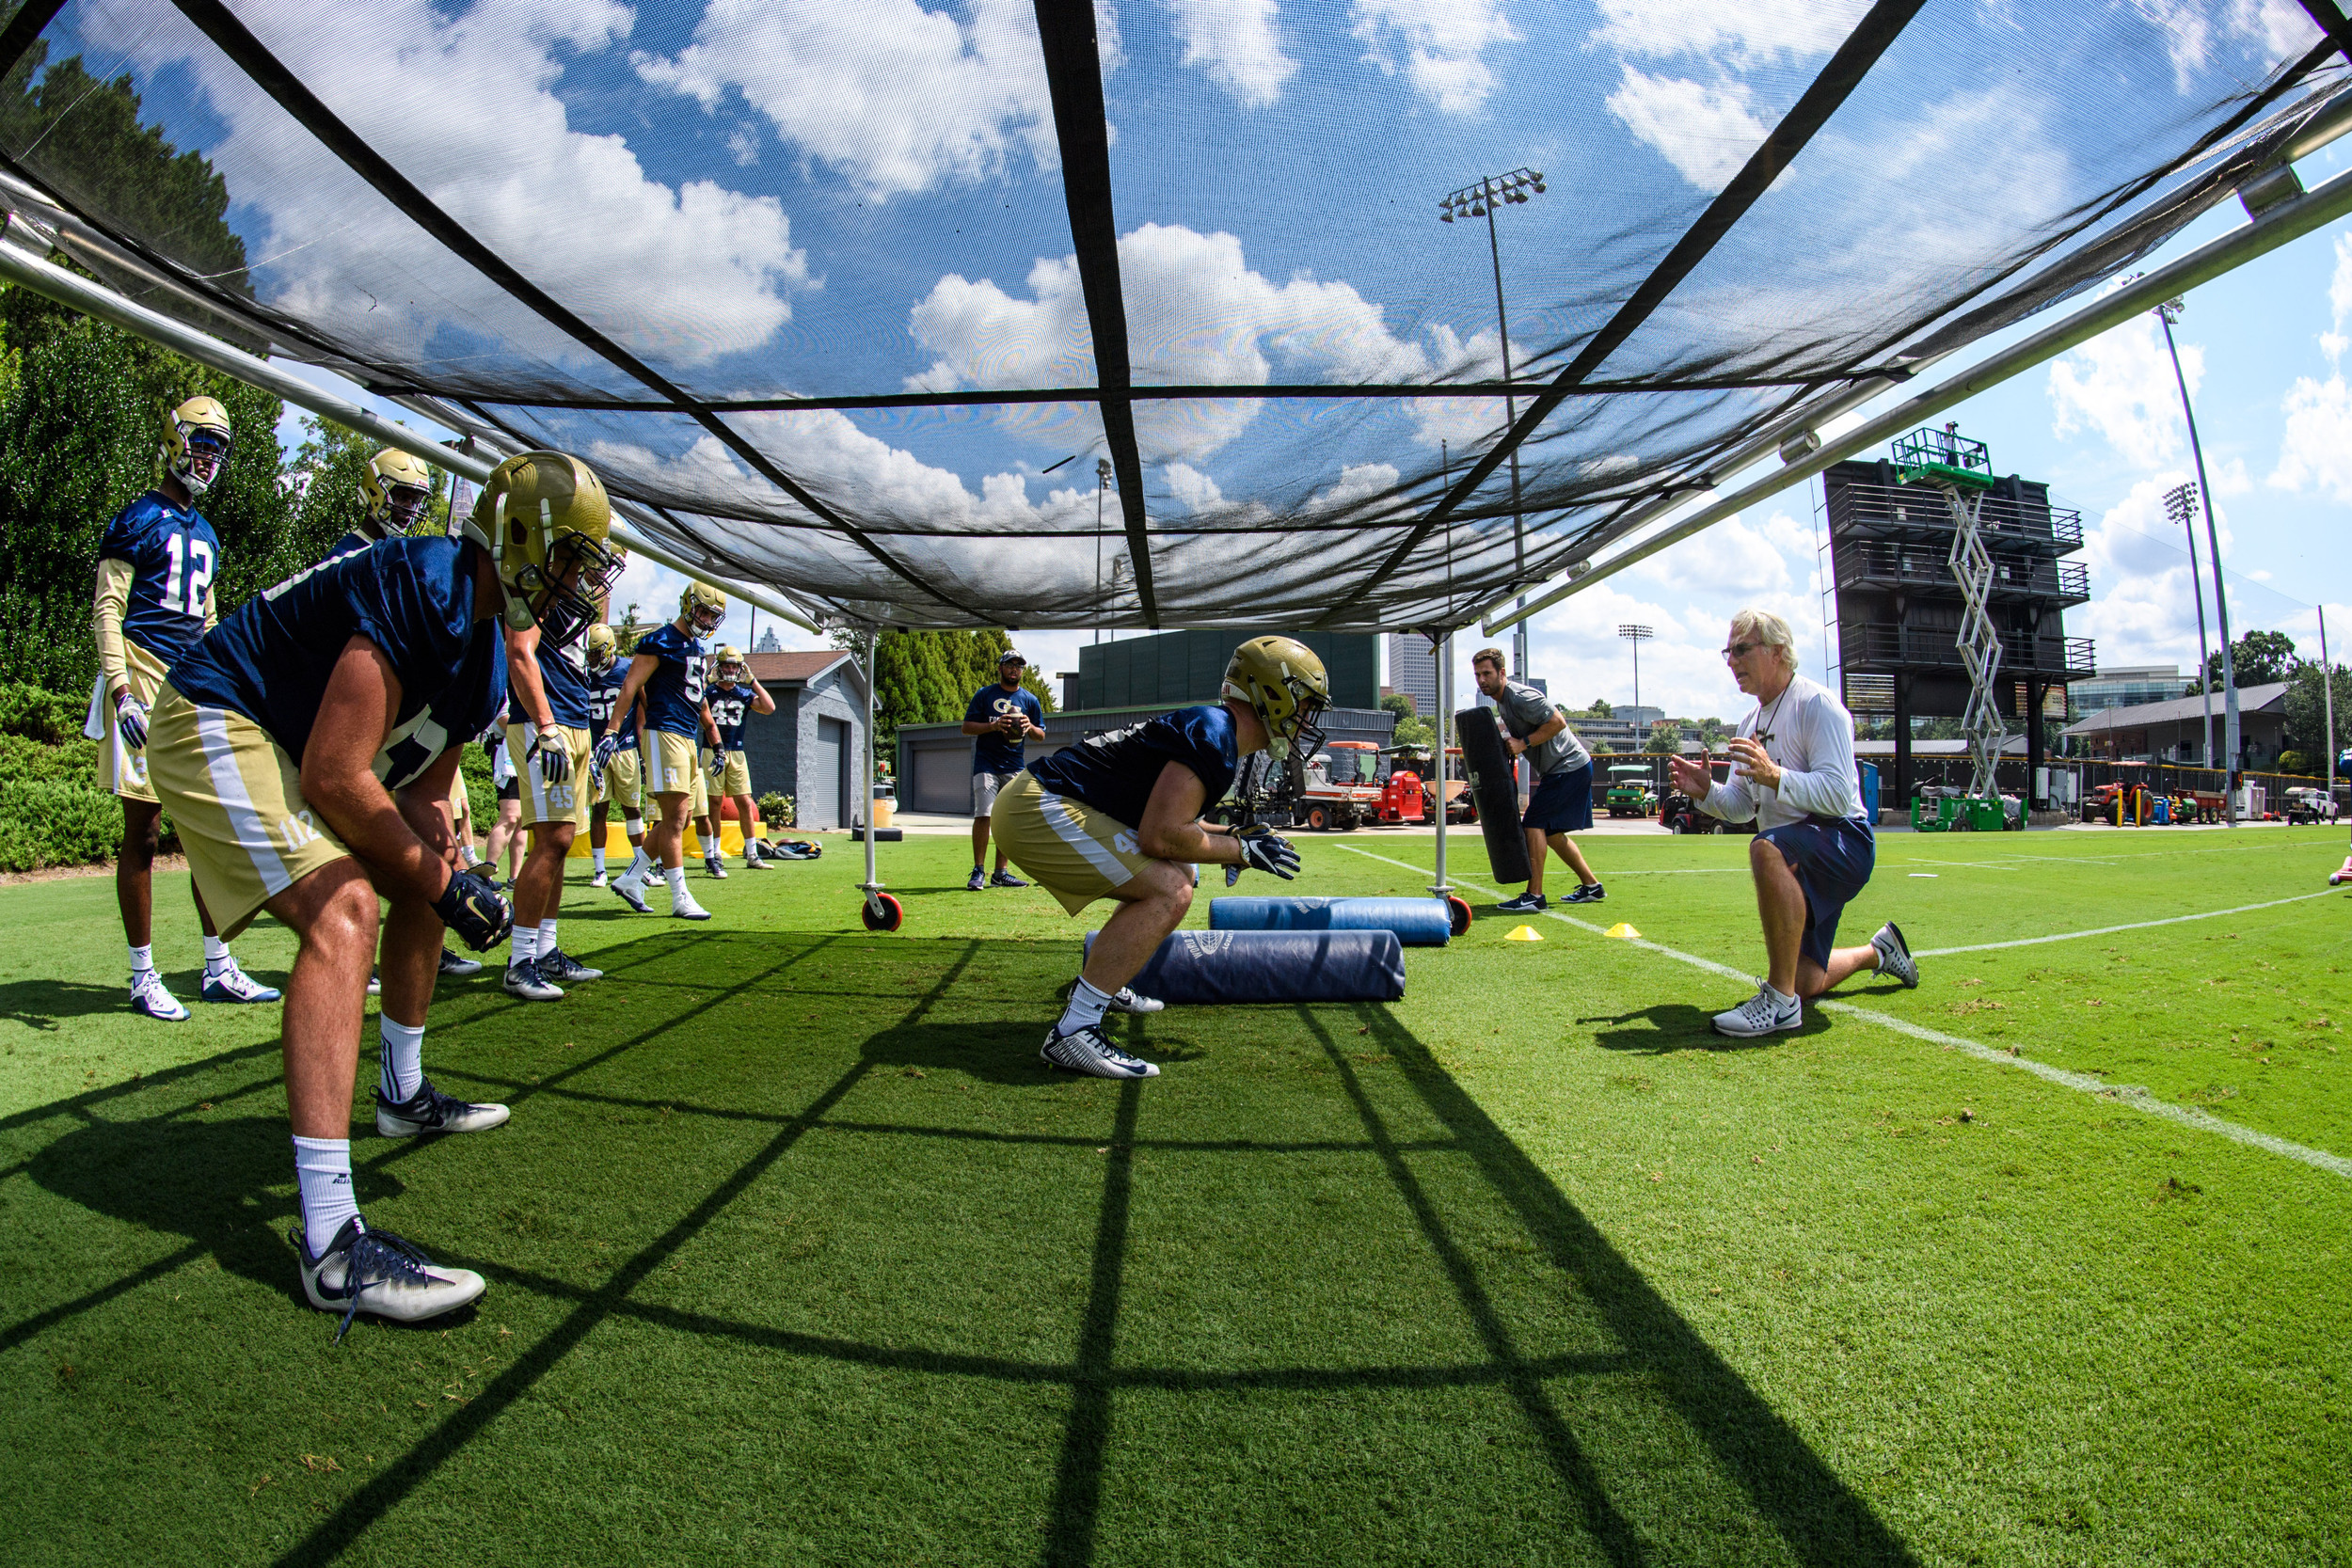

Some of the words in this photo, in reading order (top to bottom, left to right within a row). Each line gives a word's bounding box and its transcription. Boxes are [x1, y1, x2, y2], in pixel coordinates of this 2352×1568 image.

[160, 532, 214, 617] 12
[711, 699, 745, 726] 43
[664, 768, 677, 784] 51
[549, 784, 574, 809] 45
[647, 803, 657, 816] 25
[278, 810, 324, 853] 112
[1184, 938, 1203, 959] WORLD
